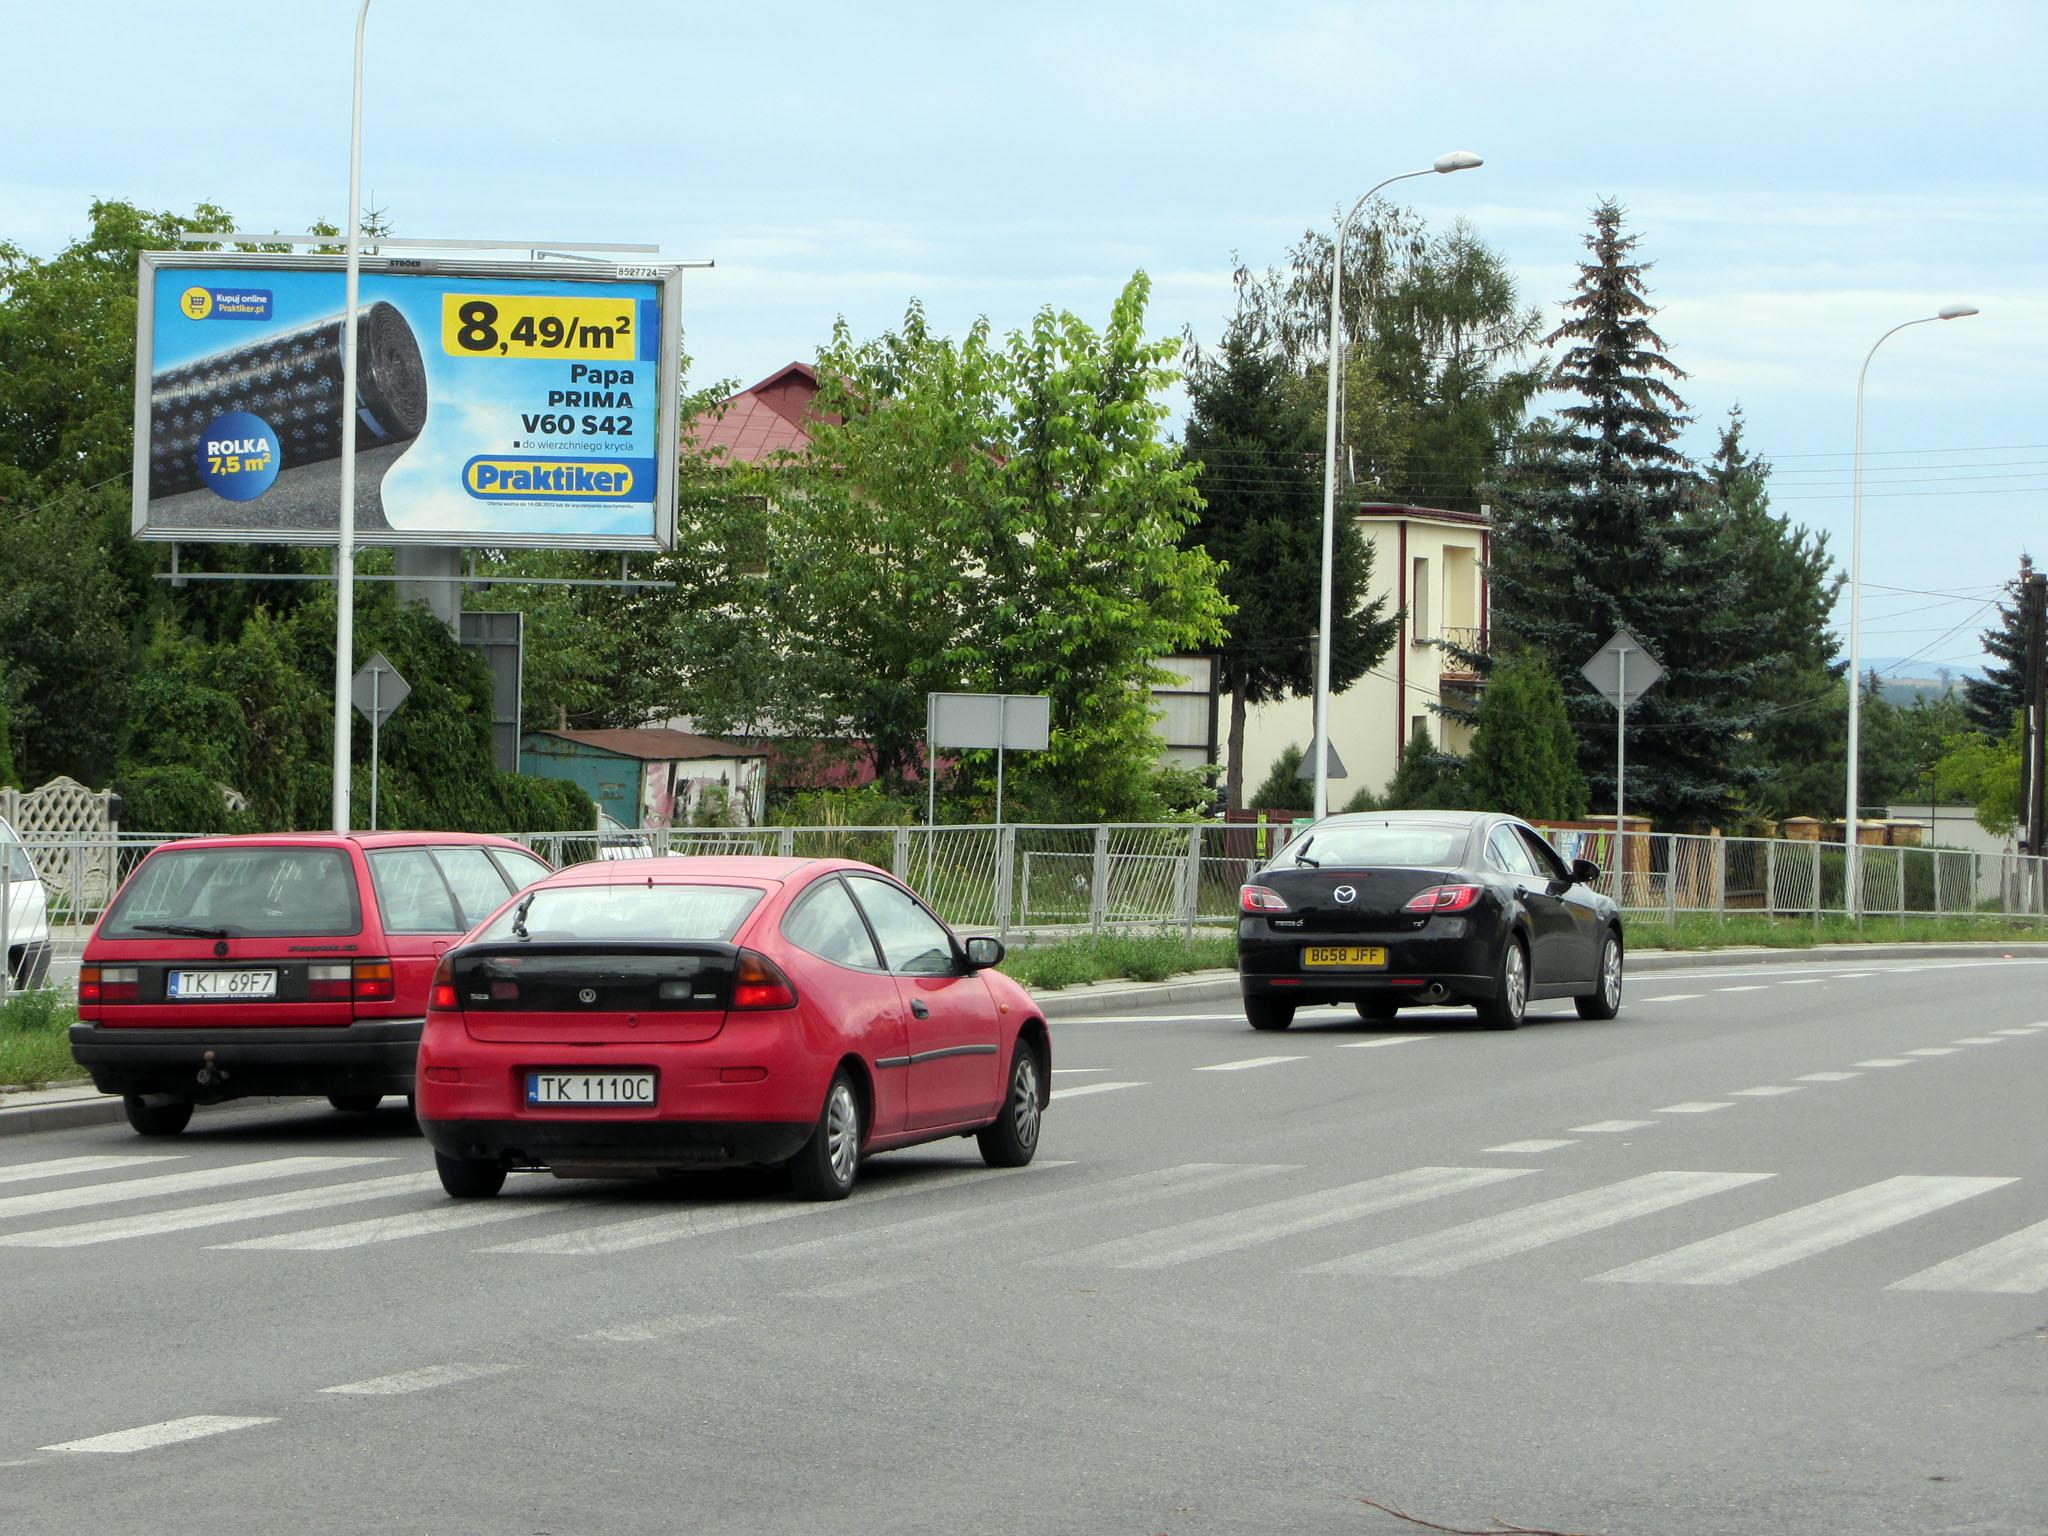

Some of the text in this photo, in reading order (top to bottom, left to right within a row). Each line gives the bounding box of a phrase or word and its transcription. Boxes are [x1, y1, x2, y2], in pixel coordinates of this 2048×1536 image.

[618, 267, 658, 278] 8527724
[216, 294, 267, 303] Kupuj online
[218, 304, 264, 314] Praktiker.pl
[571, 364, 634, 389] Papa
[548, 390, 633, 409] PRIMA
[521, 413, 633, 436] V60 S42
[207, 438, 270, 456] ROLKA
[522, 440, 634, 452] do wierzchniego krycia
[207, 456, 241, 476] 7,5
[476, 464, 629, 492] Praktiker
[1311, 948, 1378, 962] BG58 JFF
[228, 973, 273, 992] 69F7
[541, 1077, 650, 1100] TK 1110C
